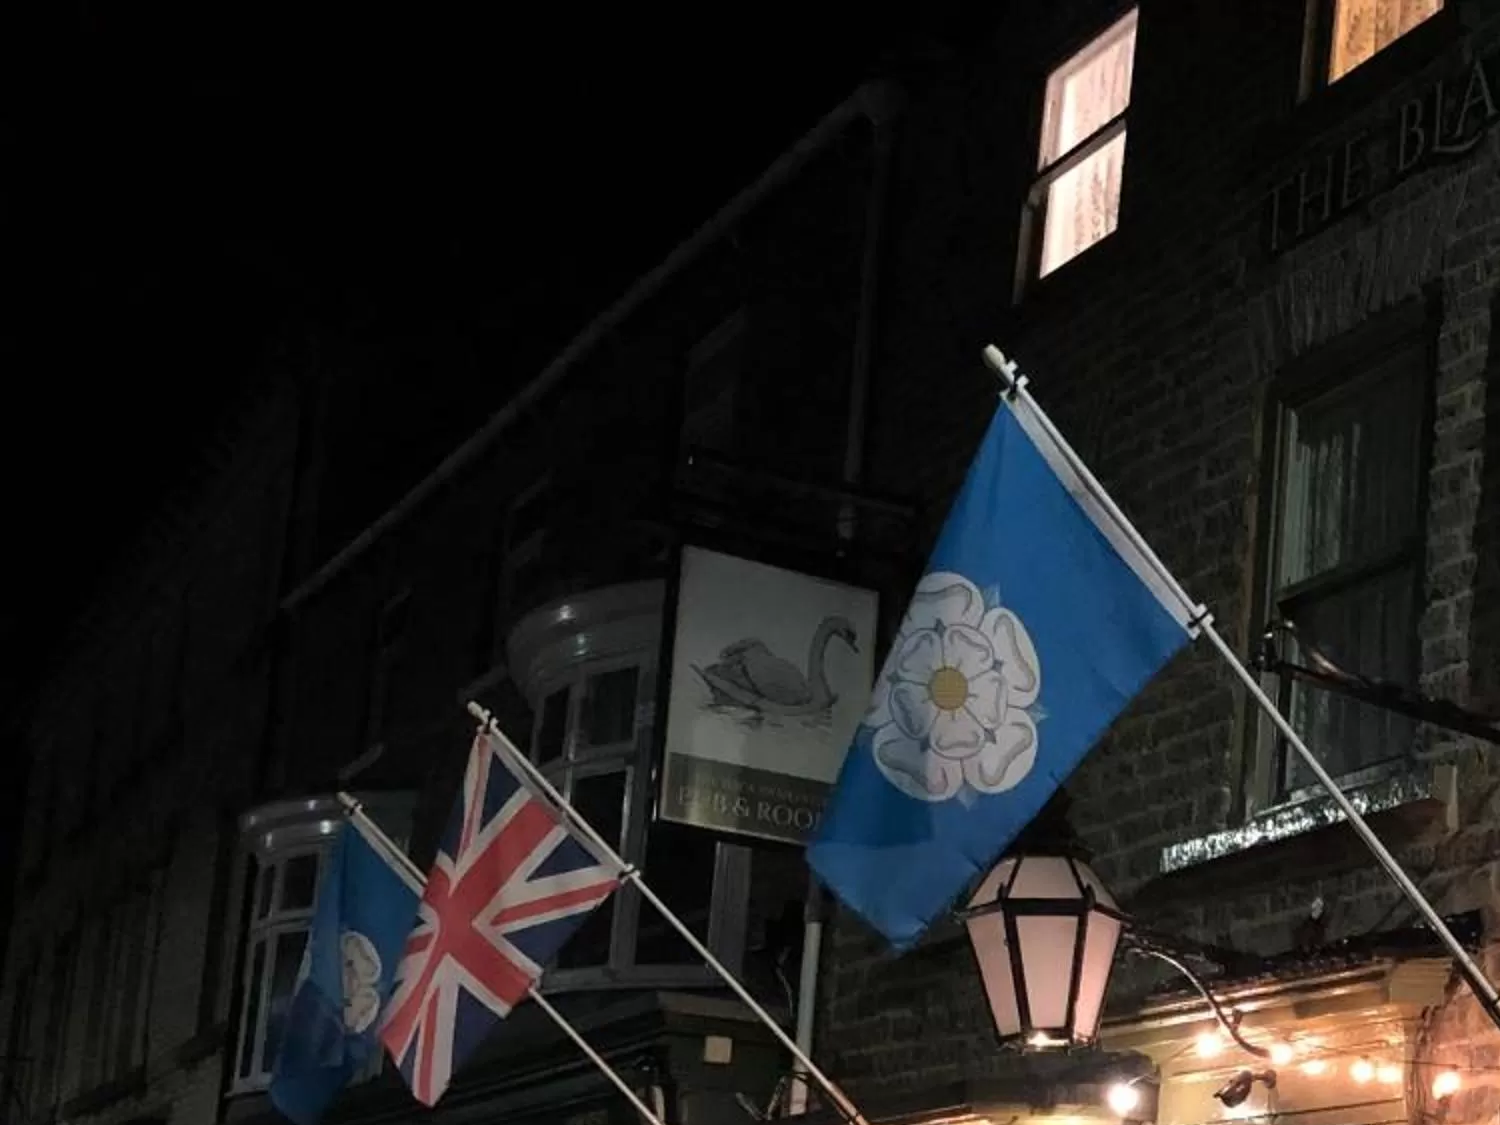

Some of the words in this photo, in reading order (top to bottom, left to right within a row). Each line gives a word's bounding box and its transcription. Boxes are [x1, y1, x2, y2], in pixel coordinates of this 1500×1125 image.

[1265, 127, 1370, 252] THE
[679, 786, 727, 814] PB
[733, 796, 749, 817] &
